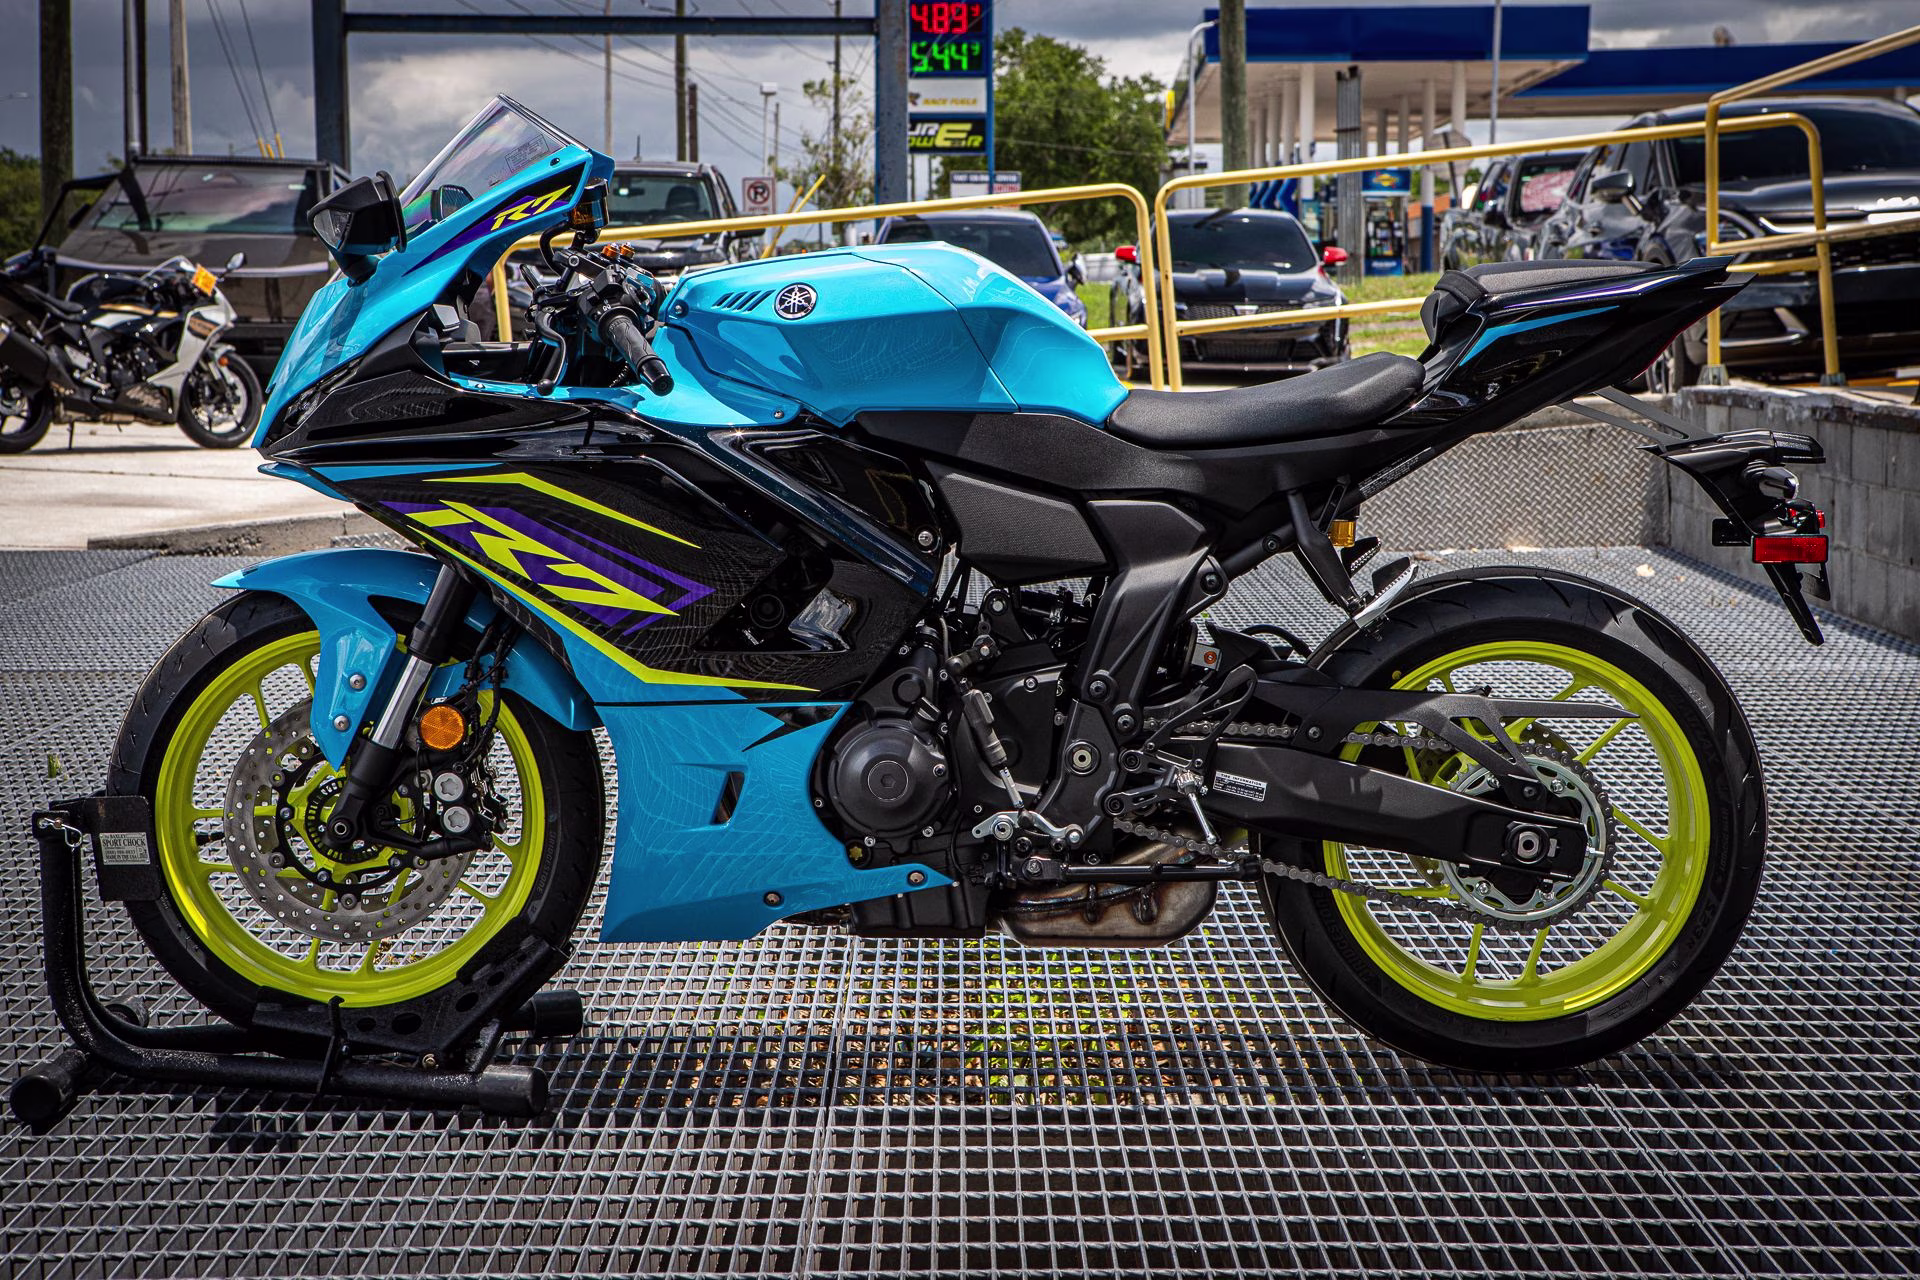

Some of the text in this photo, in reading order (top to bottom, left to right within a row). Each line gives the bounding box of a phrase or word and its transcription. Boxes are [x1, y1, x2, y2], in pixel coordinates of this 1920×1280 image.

[490, 184, 572, 231] R7
[103, 838, 146, 848] SPORT CHOCK
